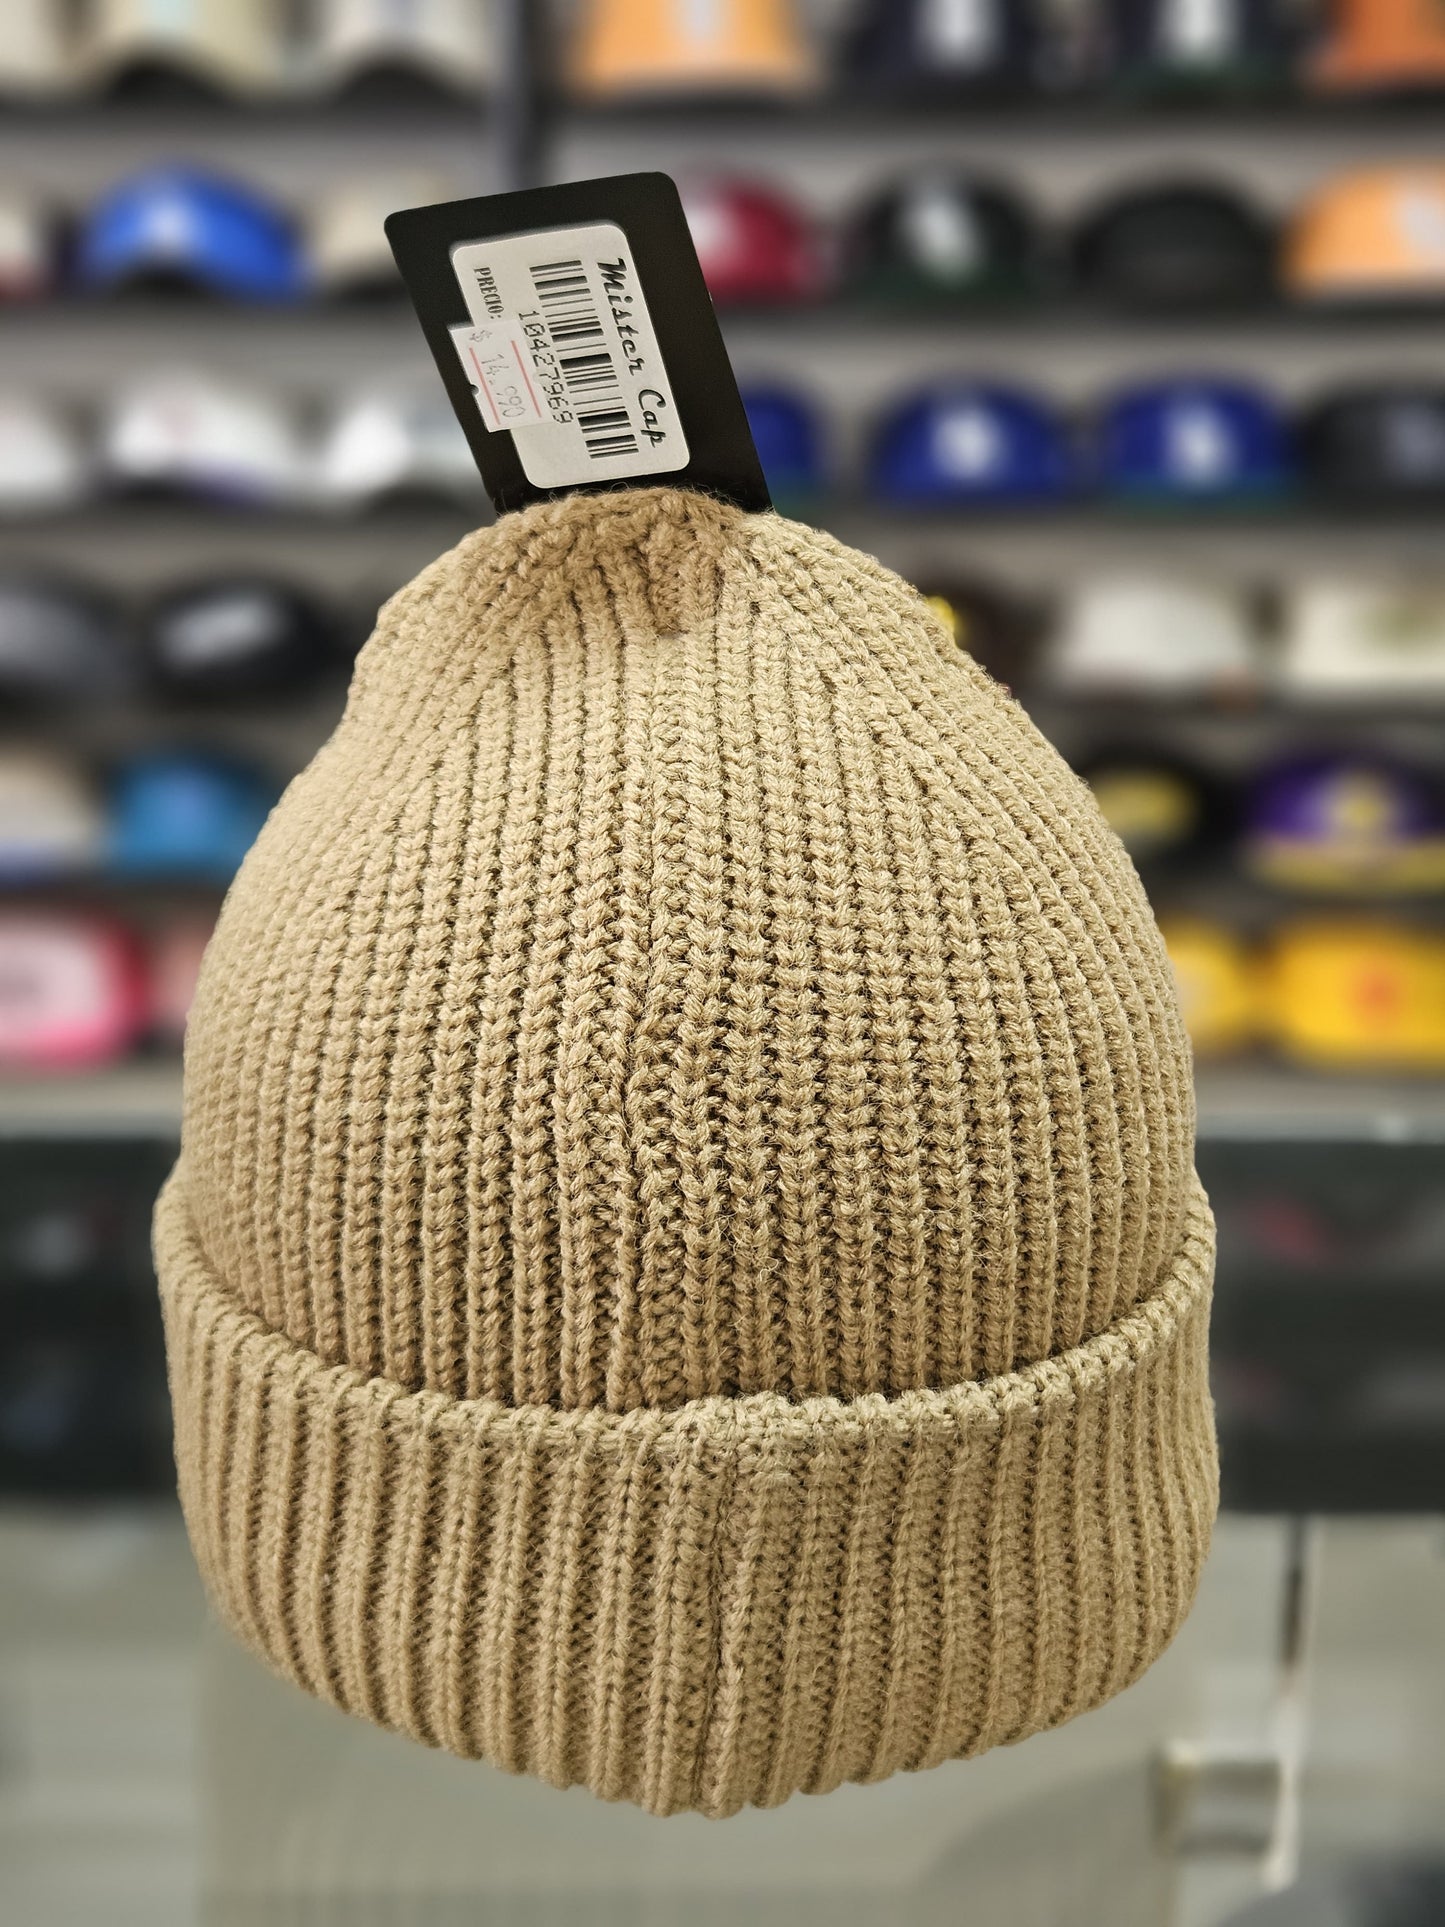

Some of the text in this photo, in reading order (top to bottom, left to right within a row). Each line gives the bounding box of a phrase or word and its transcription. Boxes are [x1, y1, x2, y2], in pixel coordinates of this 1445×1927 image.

[474, 266, 505, 319] PRECIO:
[469, 329, 493, 343] $
[518, 310, 575, 425] 10427969
[597, 257, 667, 448] Mister Cap
